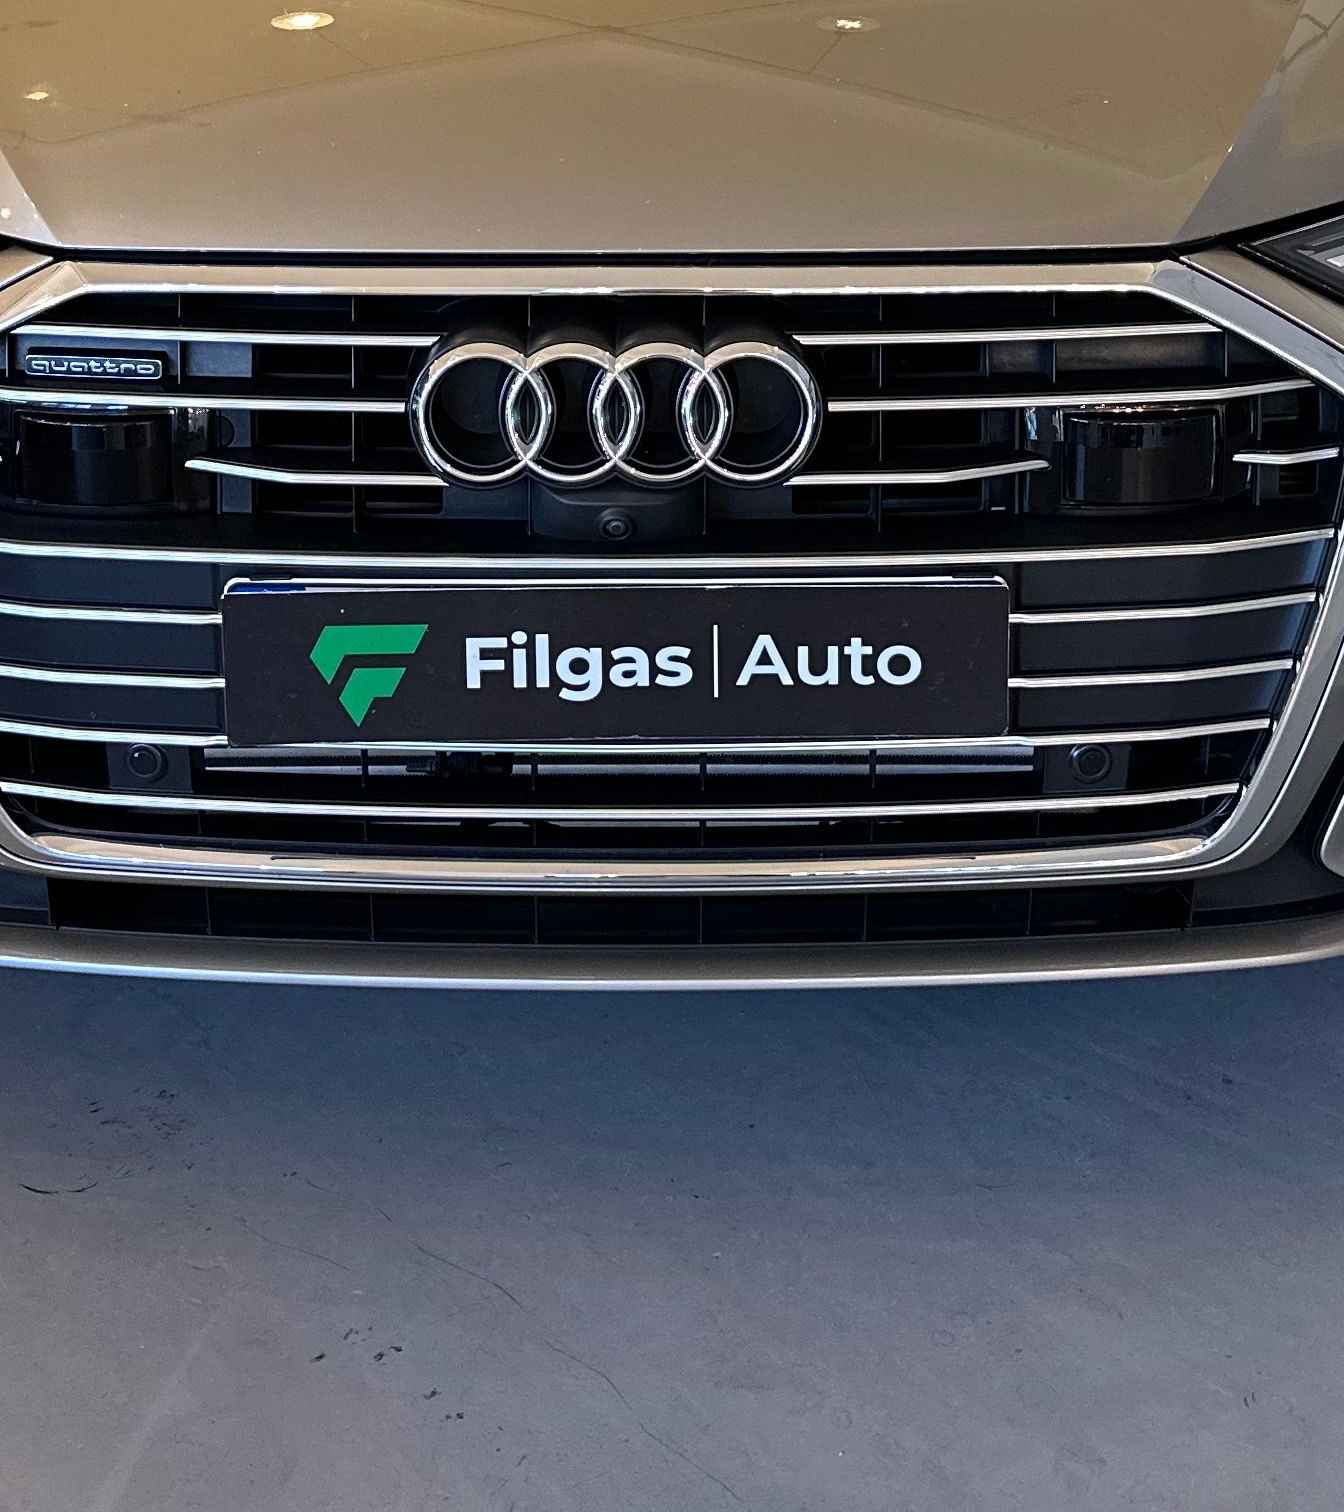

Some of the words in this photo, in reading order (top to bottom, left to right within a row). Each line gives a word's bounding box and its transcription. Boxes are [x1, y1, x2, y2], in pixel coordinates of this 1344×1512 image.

[31, 360, 155, 374] quattro
[465, 631, 692, 702] Filgas
[736, 634, 923, 687] Auto
